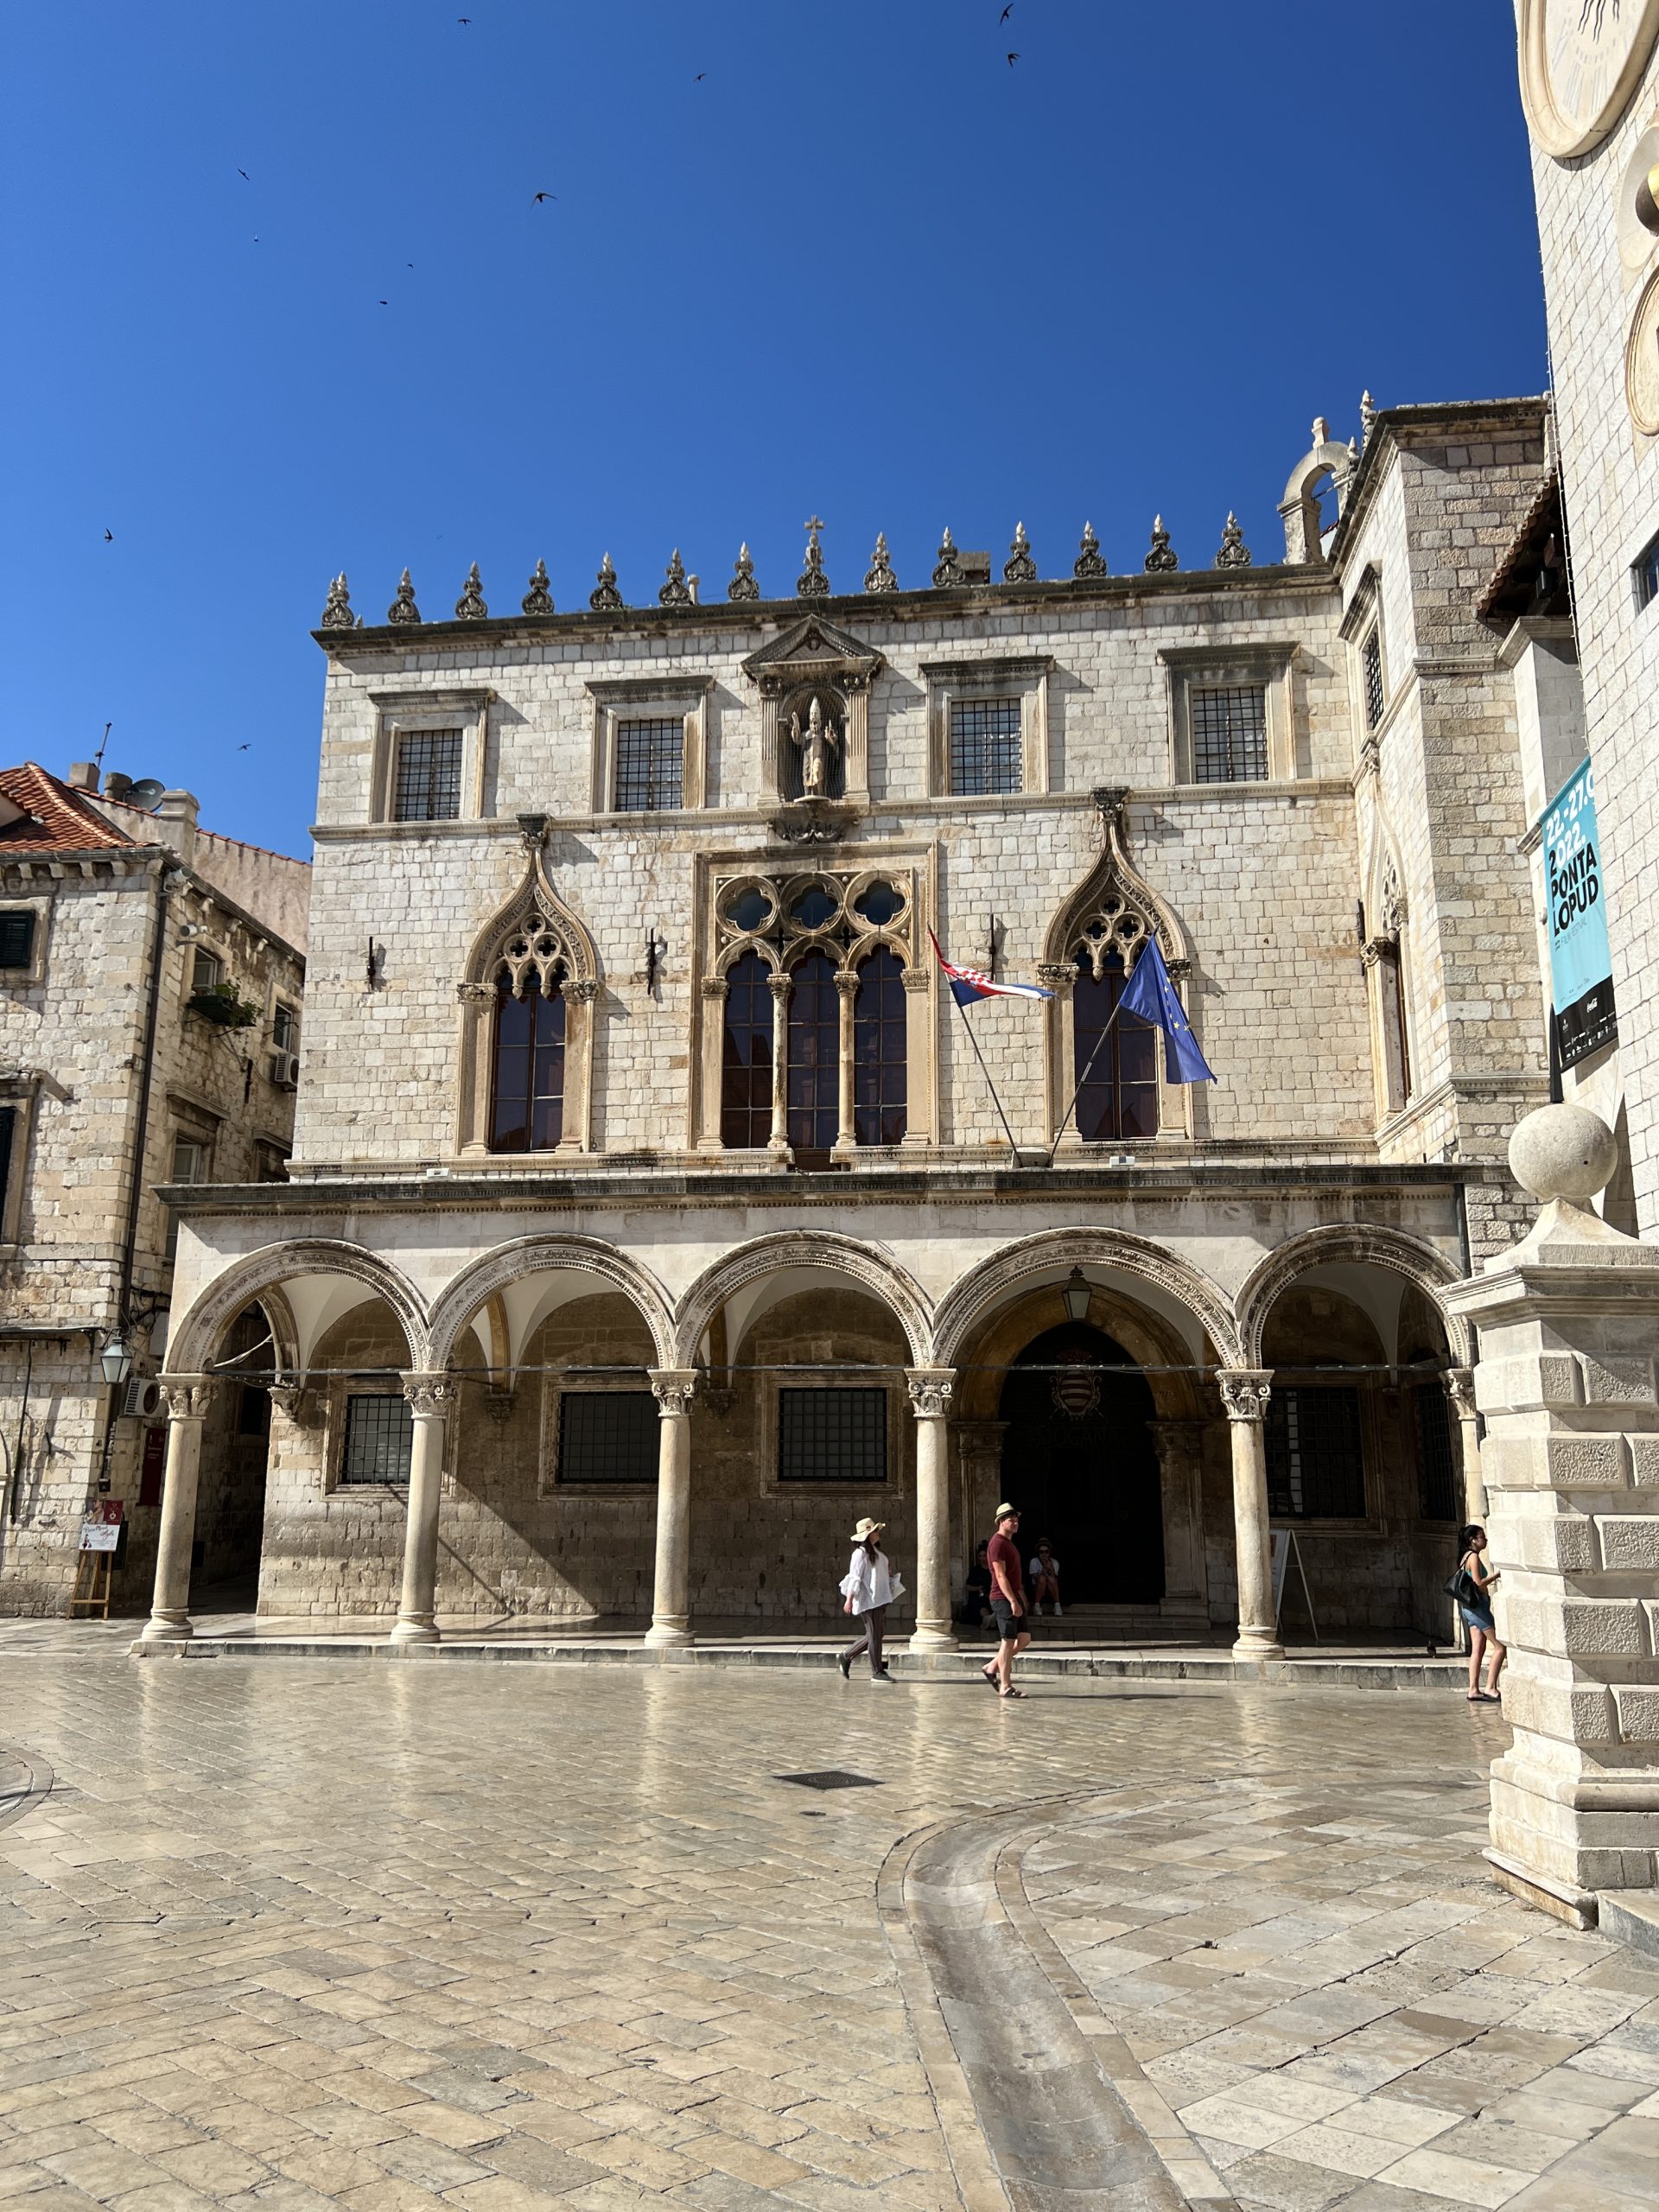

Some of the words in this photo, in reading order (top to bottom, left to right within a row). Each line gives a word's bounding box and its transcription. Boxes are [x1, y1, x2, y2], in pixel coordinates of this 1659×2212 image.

[1548, 821, 1586, 879] 2022.
[1551, 842, 1598, 909] PONTA
[1553, 874, 1599, 938] LOPUD
